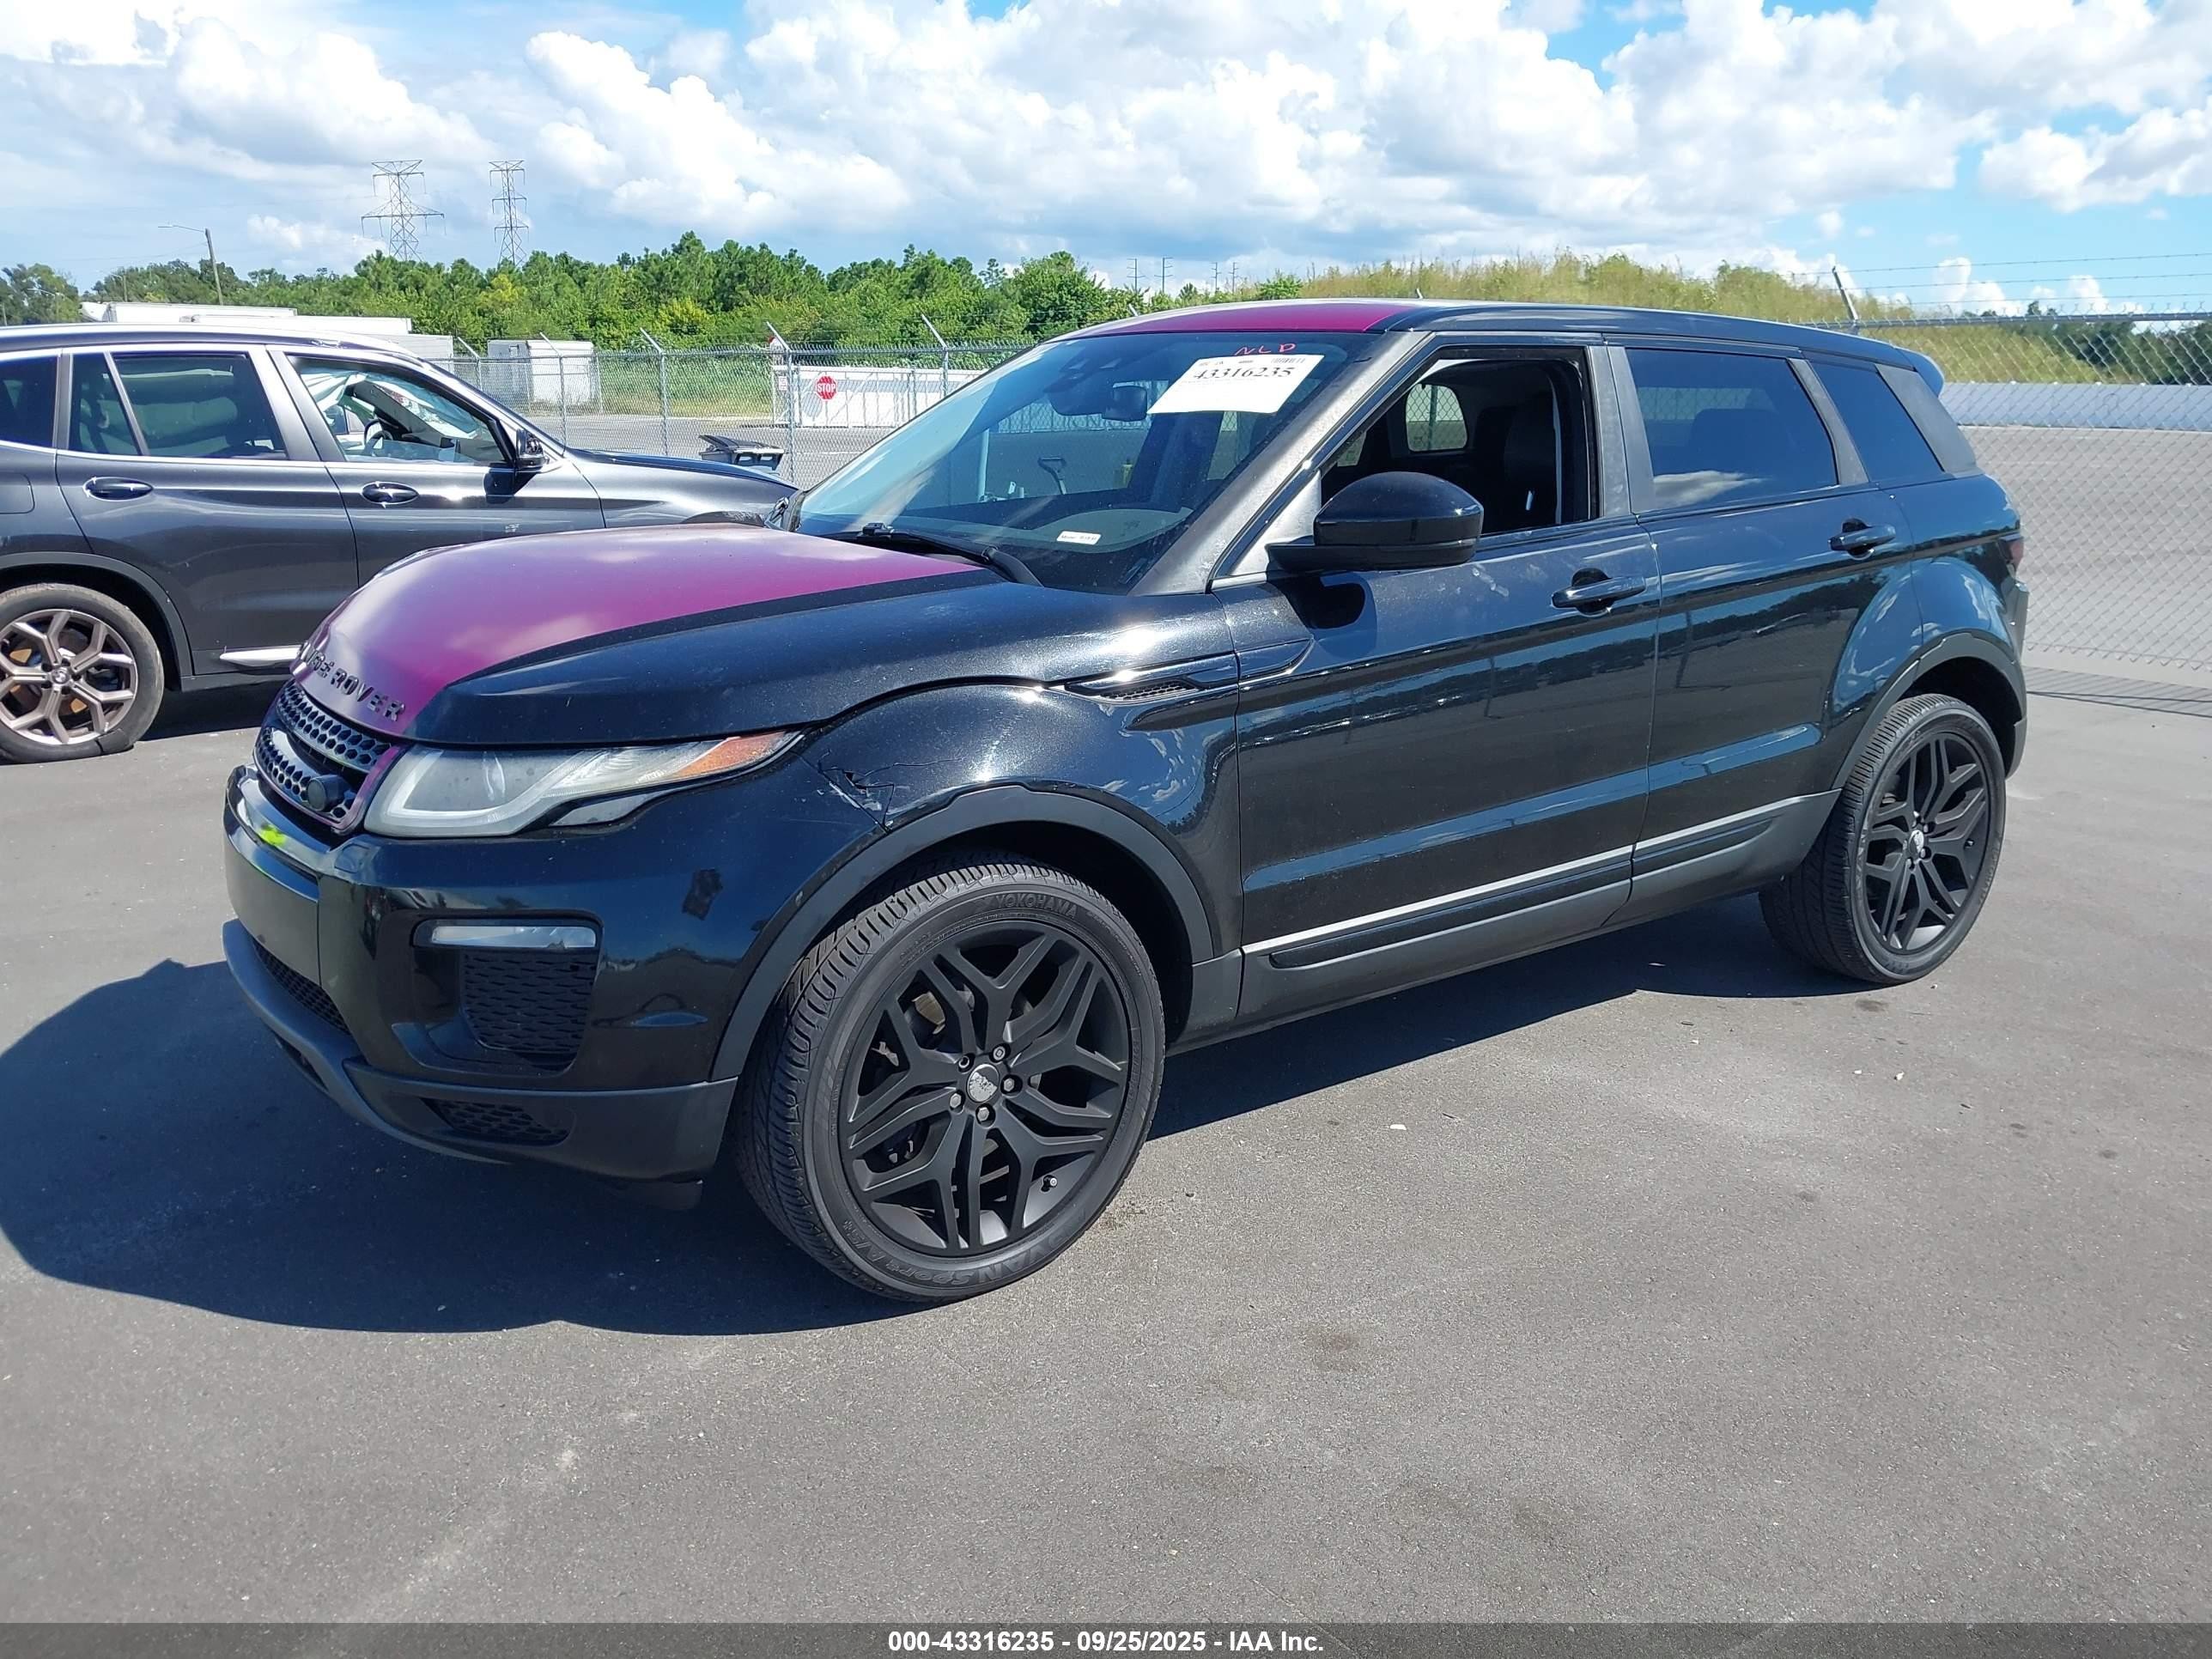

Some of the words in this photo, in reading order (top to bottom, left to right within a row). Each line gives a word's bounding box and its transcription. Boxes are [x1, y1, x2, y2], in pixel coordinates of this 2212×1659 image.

[1194, 367, 1295, 380] 43316235
[817, 383, 836, 393] STOP
[330, 667, 406, 722] ROVER
[996, 894, 1078, 918] YOKOHAMA
